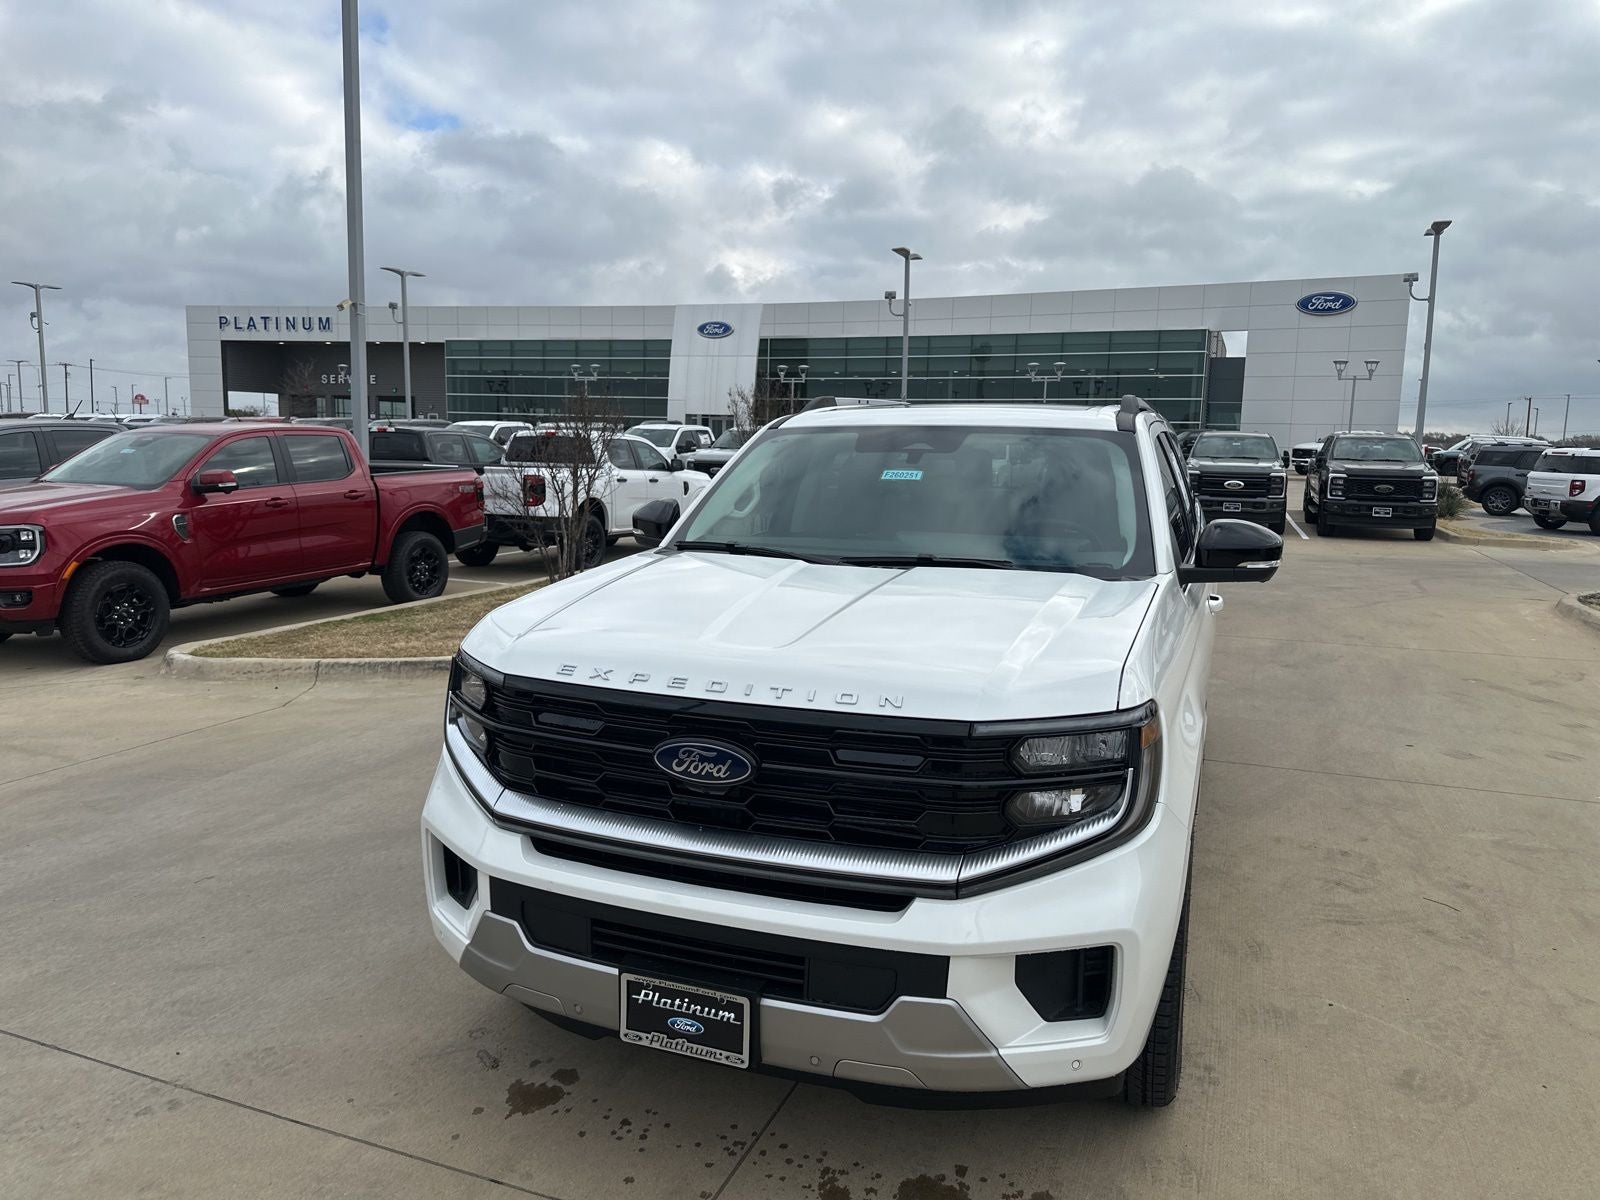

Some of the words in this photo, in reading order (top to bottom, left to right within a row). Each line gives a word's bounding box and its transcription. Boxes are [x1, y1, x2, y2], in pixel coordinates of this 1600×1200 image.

[218, 315, 333, 332] PLATINUM
[556, 664, 904, 710] EXPEDITION
[672, 747, 733, 780] Ford
[631, 989, 742, 1025] Platinum
[649, 1032, 723, 1060] Platinum
